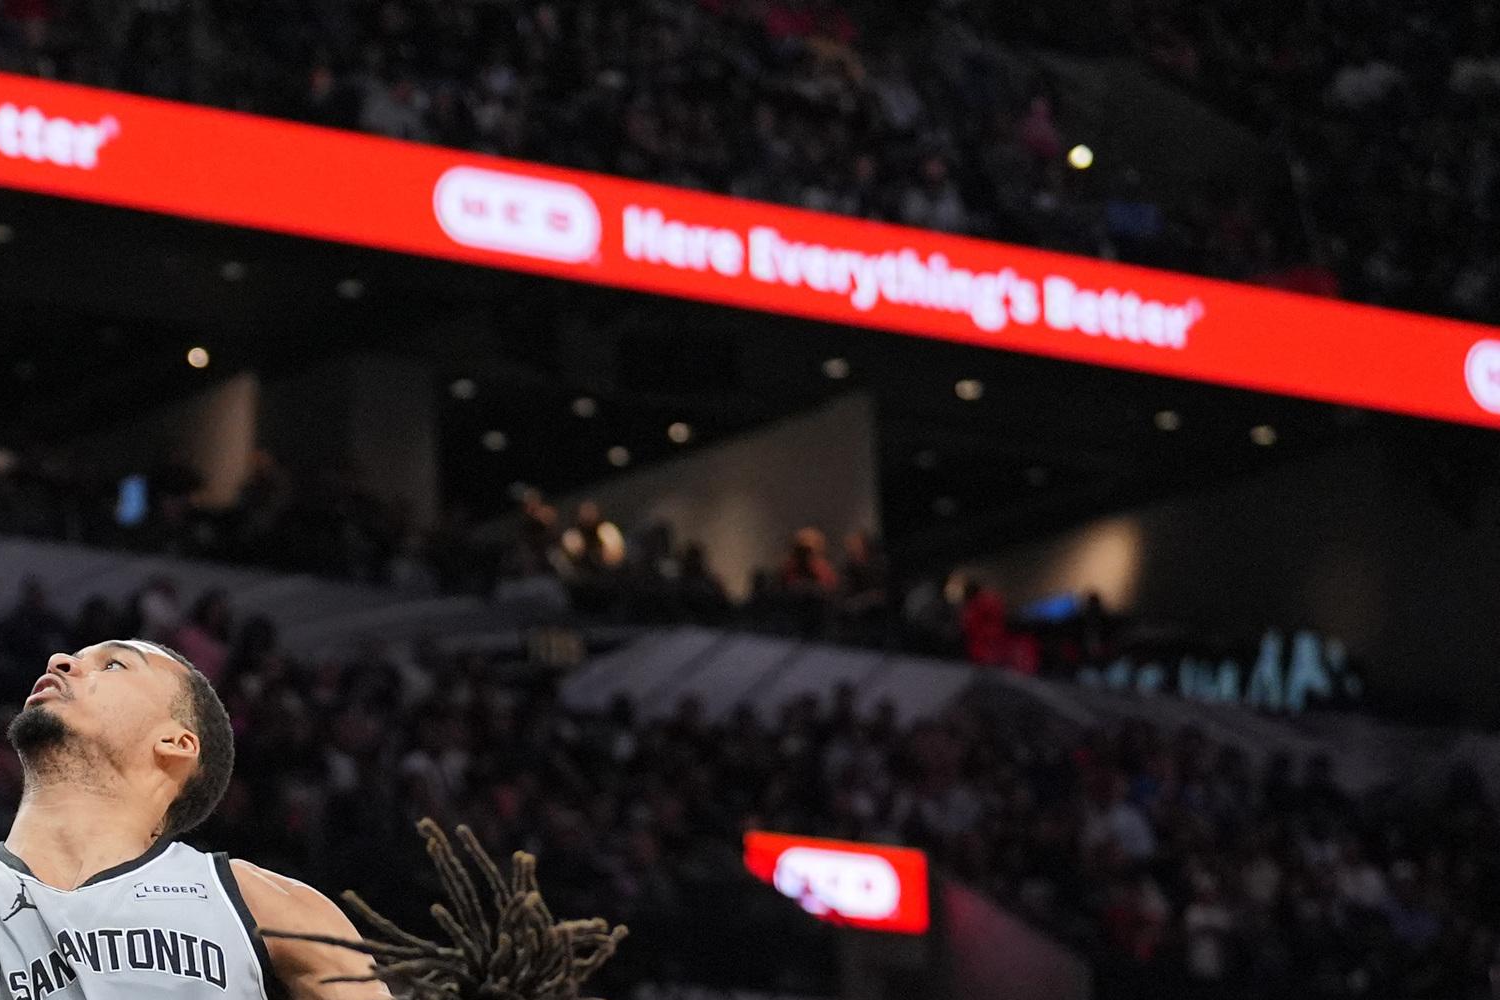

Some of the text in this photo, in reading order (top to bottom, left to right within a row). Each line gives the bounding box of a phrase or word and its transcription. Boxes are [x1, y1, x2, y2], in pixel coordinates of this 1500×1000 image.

[622, 204, 744, 278] Here
[748, 226, 1039, 332] Everything's
[1043, 275, 1190, 349] Better
[143, 885, 198, 894] LEDGER
[55, 927, 228, 992] ANTONIO
